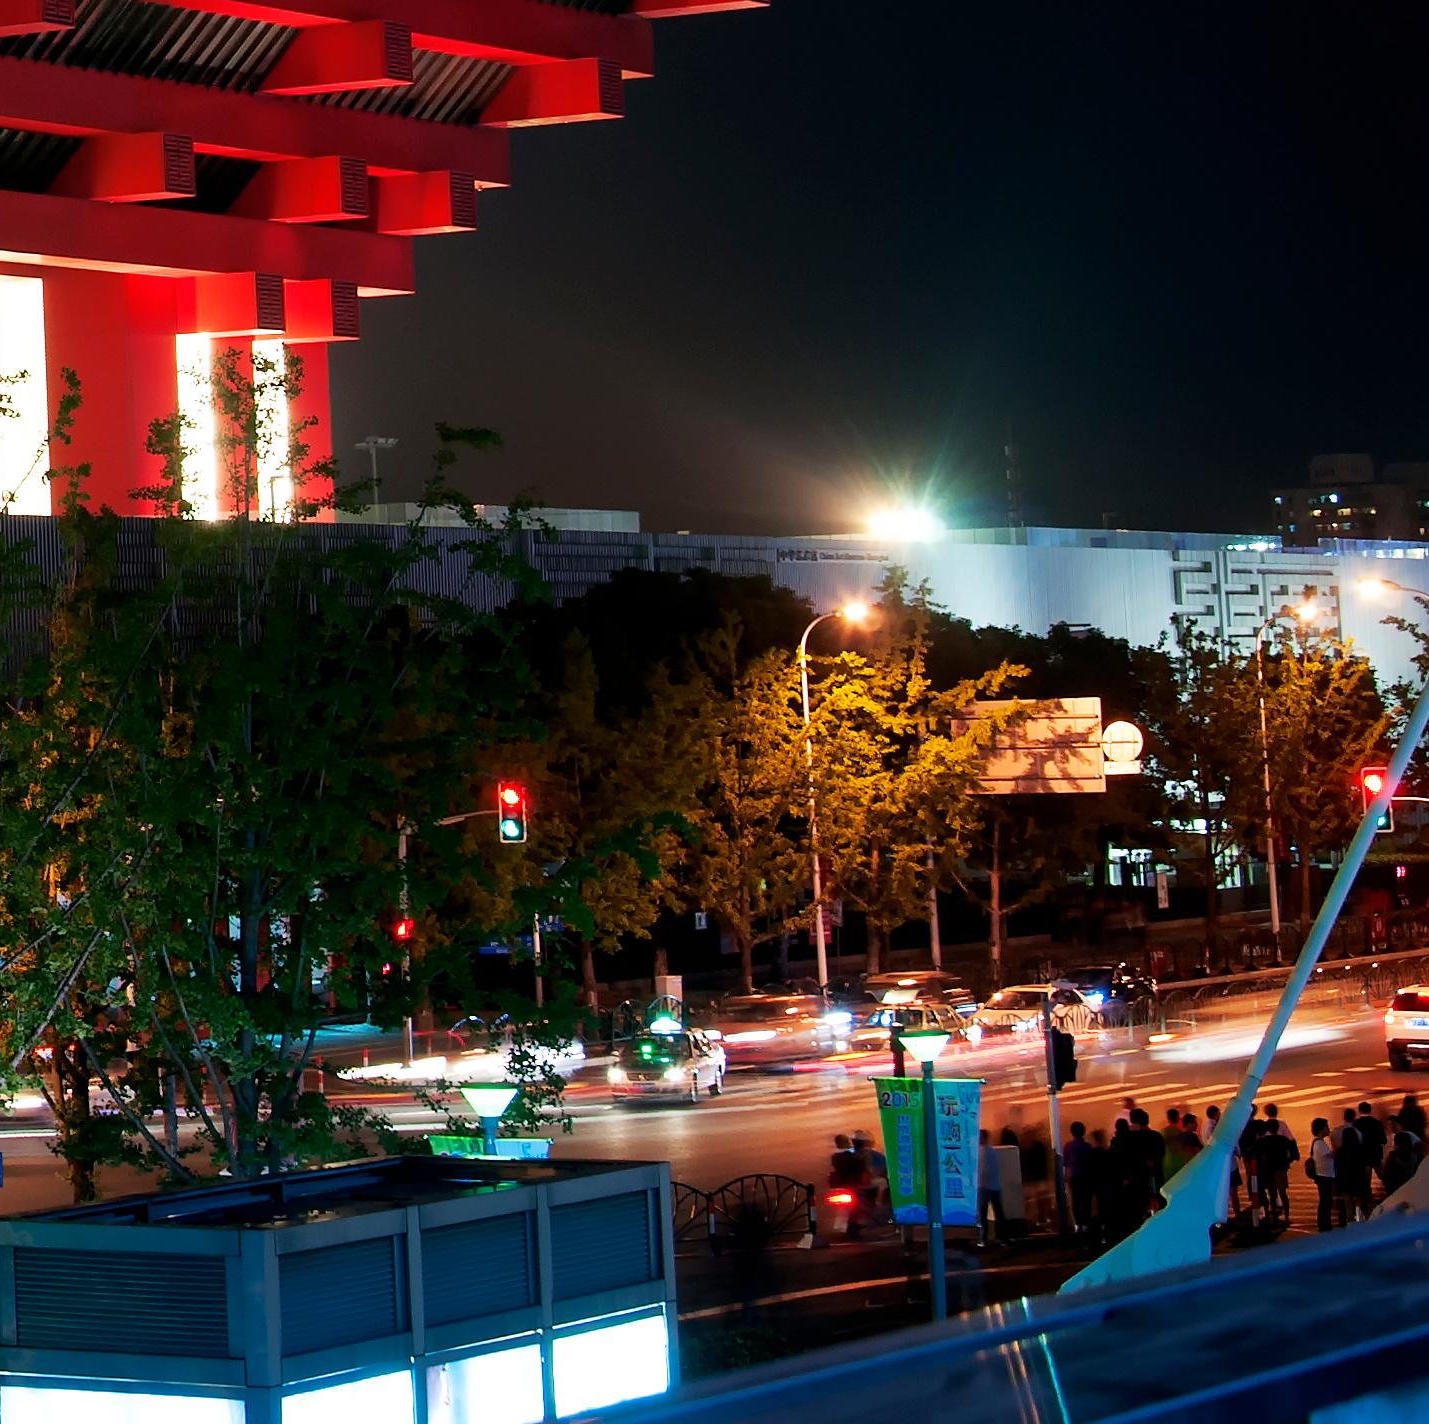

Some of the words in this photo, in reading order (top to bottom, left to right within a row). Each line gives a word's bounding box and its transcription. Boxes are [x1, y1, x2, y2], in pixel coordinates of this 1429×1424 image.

[882, 1091, 919, 1108] 2015
[937, 1095, 965, 1199] 玩购一公里
